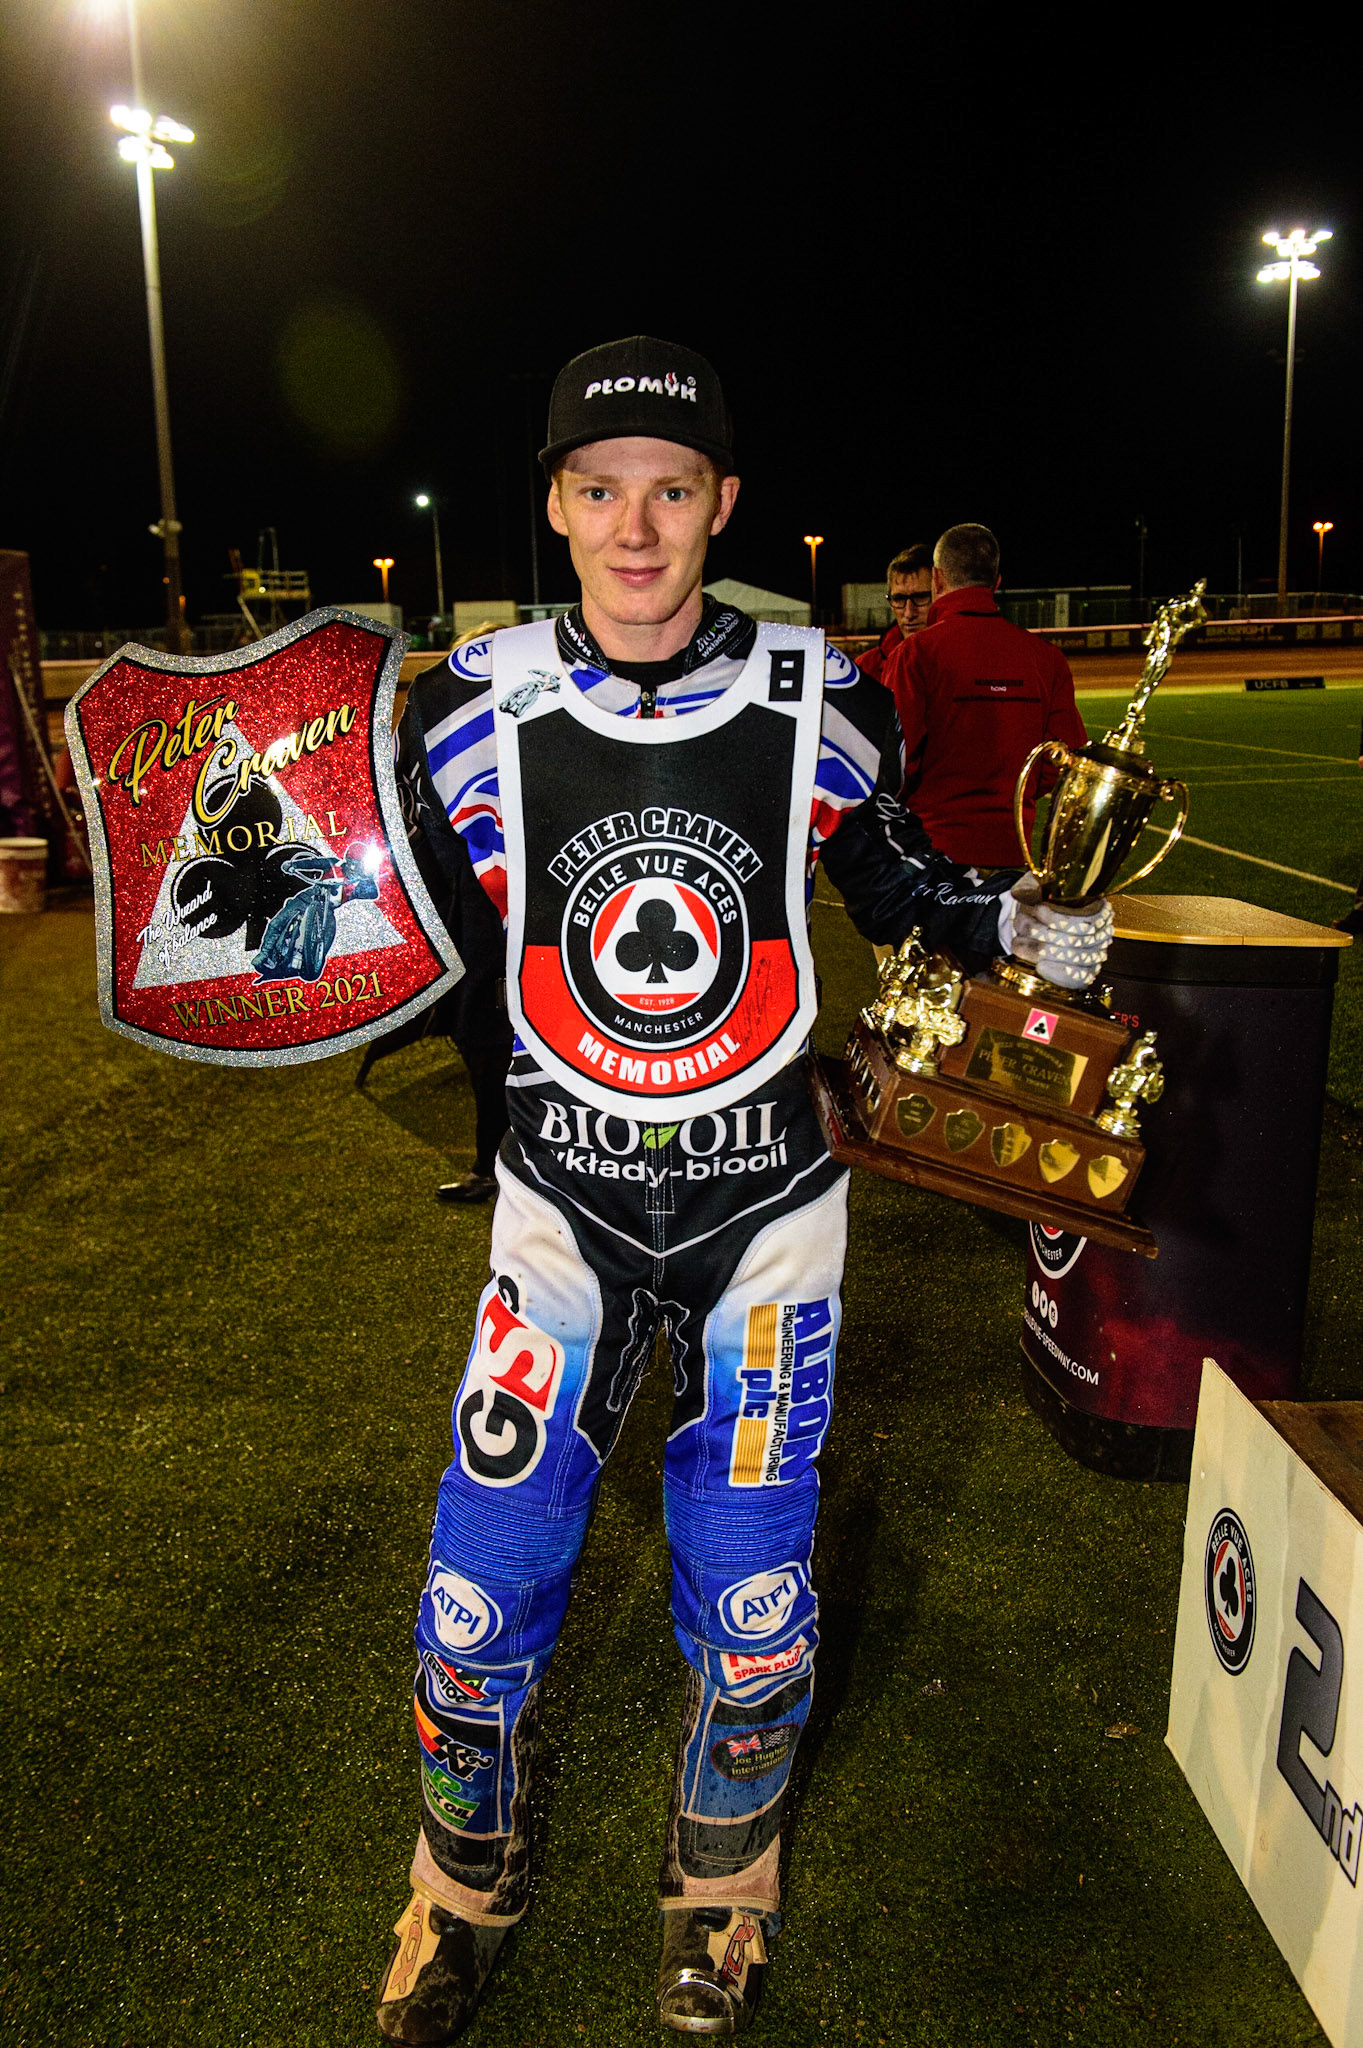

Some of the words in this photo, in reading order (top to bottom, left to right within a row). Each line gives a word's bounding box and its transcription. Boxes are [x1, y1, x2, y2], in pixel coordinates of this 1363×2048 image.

[768, 650, 805, 702] 8
[107, 694, 240, 807] Peter
[191, 702, 357, 829] Craven
[139, 809, 348, 868] MEMORIAL
[547, 811, 639, 887] PETER
[640, 806, 763, 884] CRAVEN
[136, 925, 163, 948] The
[162, 880, 213, 931] Wizard
[573, 864, 627, 928] BELLE
[636, 855, 688, 878] VUE
[694, 871, 738, 924] ACES
[158, 940, 171, 968] of
[172, 912, 218, 952] balance
[172, 986, 311, 1031] WINNER
[318, 970, 385, 1010] 2021
[614, 1011, 704, 1034] MANCHESTER
[639, 997, 656, 1006] EST.
[577, 1031, 741, 1085] MEMORIAL
[538, 1099, 640, 1156] BIO
[679, 1101, 787, 1156] OIL
[779, 1305, 796, 1380] ENGINEERING
[740, 1369, 777, 1418] plc
[778, 1383, 786, 1391] &
[765, 1392, 790, 1482] MANUFACTURING
[1211, 1523, 1228, 1553] BELLE
[1230, 1524, 1244, 1552] VUE
[433, 1586, 480, 1635] ATPI
[742, 1579, 790, 1625] ATPI
[734, 1665, 772, 1680] SPARK
[734, 1757, 751, 1765] Joe
[444, 1803, 470, 1819] OIL
